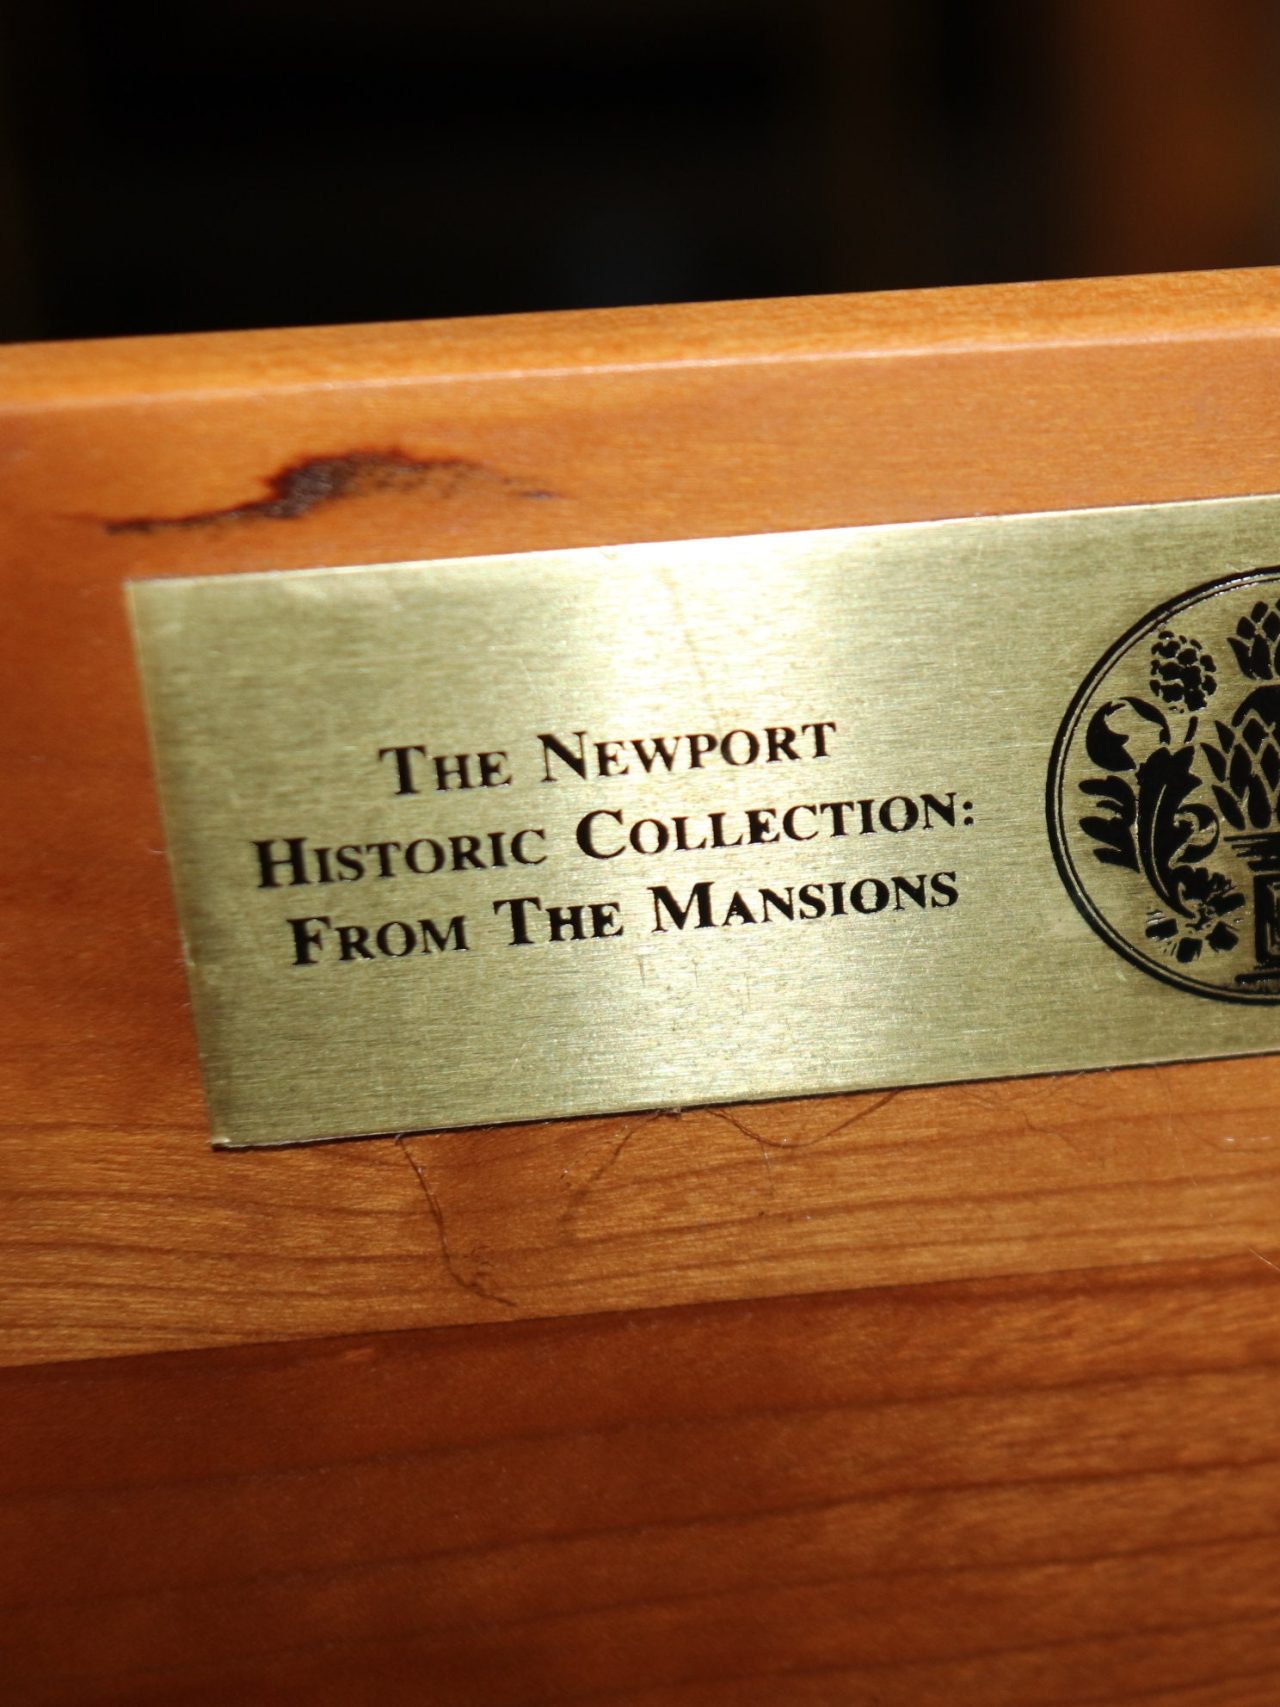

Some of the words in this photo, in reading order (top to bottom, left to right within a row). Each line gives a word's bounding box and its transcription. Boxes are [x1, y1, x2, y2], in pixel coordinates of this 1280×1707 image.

[378, 744, 512, 796] THE
[538, 721, 838, 782] NEWPORT
[252, 828, 548, 889] HISTORIC
[575, 791, 975, 860] COLLECTION:
[286, 914, 469, 966] FROM
[494, 897, 624, 946] THE
[649, 871, 960, 934] MANSIONS
